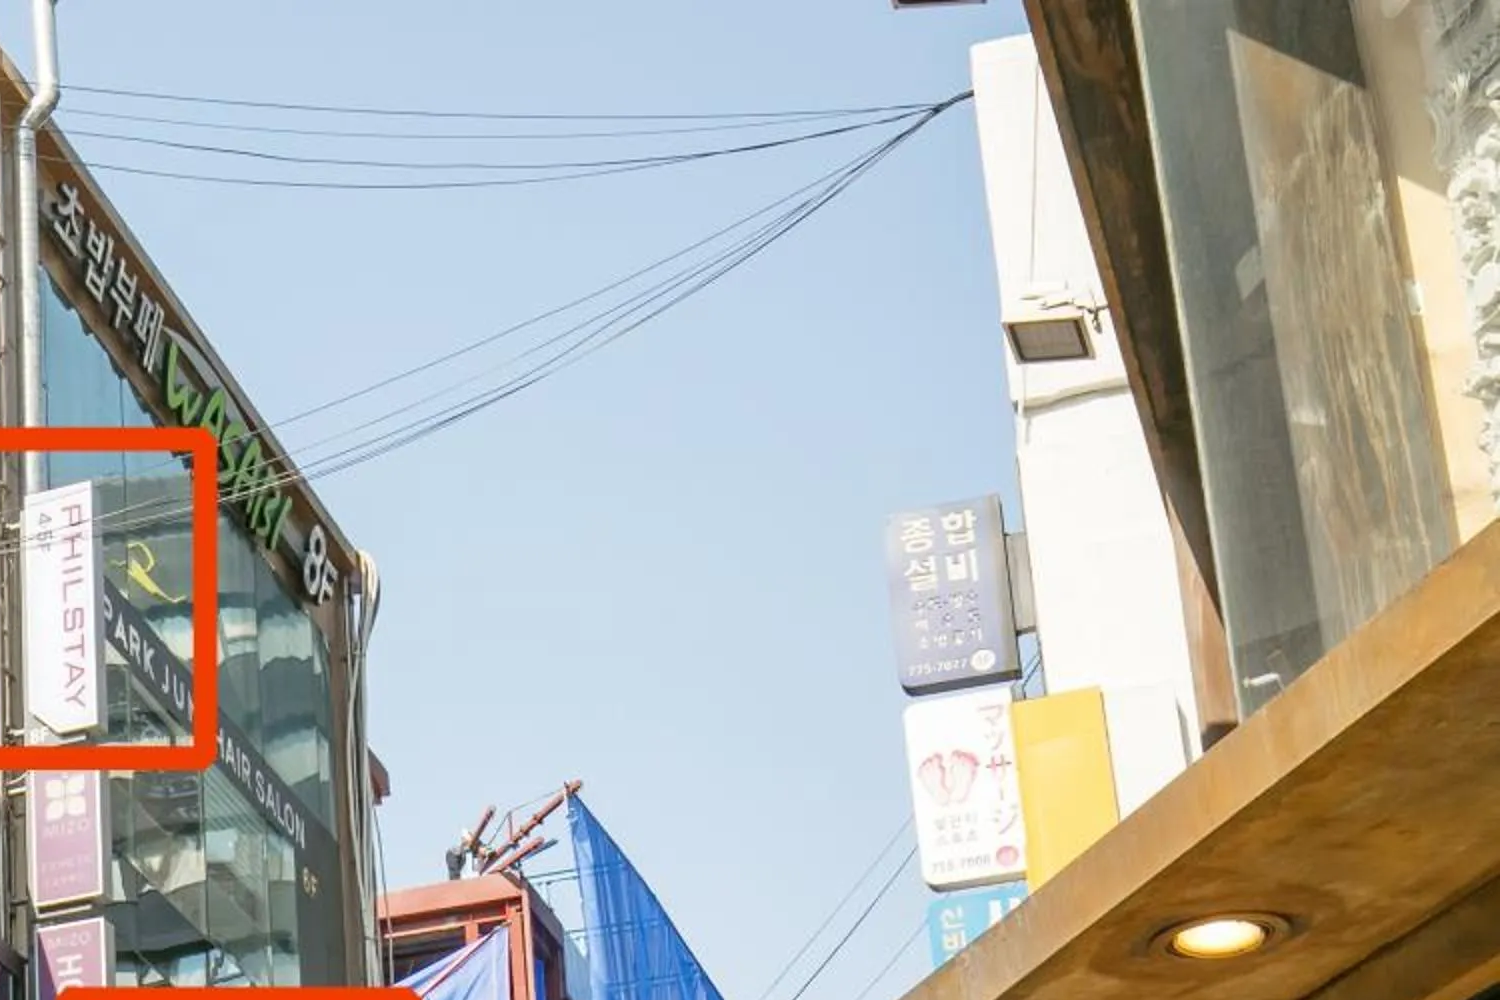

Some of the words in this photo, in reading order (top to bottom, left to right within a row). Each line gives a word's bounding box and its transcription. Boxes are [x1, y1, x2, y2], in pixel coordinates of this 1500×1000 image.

[53, 182, 164, 374] 초밥부페
[303, 524, 338, 605] 8F
[900, 509, 978, 553] 종합
[904, 549, 979, 592] 설비
[61, 503, 88, 708] PHILSTAY
[103, 594, 156, 681] PARK
[255, 769, 305, 849] SALON
